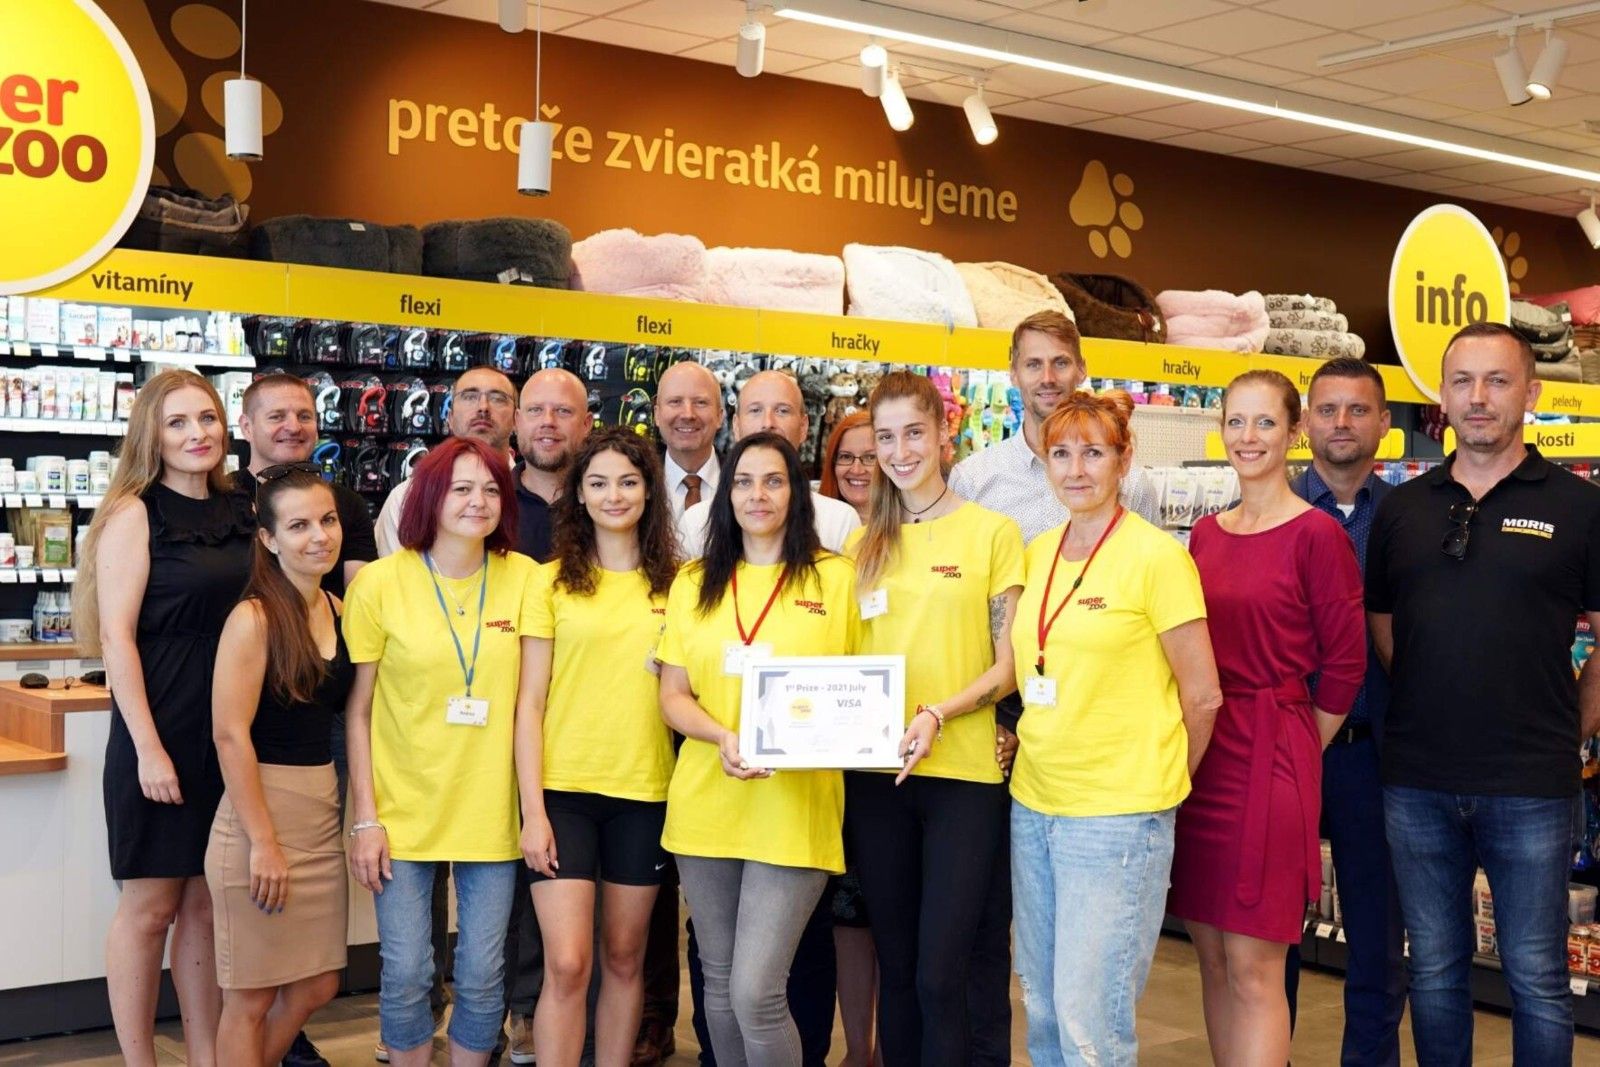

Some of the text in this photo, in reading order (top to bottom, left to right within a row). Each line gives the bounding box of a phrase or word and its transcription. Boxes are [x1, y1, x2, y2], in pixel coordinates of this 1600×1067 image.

[604, 127, 821, 195] zvieratká
[834, 159, 1018, 226] milujeme
[91, 270, 194, 302] vitamíny
[400, 294, 441, 316] flexi
[1415, 270, 1488, 327] info
[637, 315, 672, 335] flexi
[831, 331, 880, 356] hračky
[1163, 358, 1201, 380] hračky
[1552, 396, 1583, 410] pelechy
[1536, 432, 1575, 447] kosti
[1502, 518, 1555, 533] MORIS
[931, 565, 959, 573] super
[794, 599, 824, 609] super
[1077, 597, 1104, 606] super
[1088, 603, 1107, 611] zoo
[808, 607, 827, 616] zoo
[486, 619, 511, 629] super
[796, 684, 819, 692] Prize
[826, 684, 847, 692] 2021
[837, 699, 862, 708] VISA
